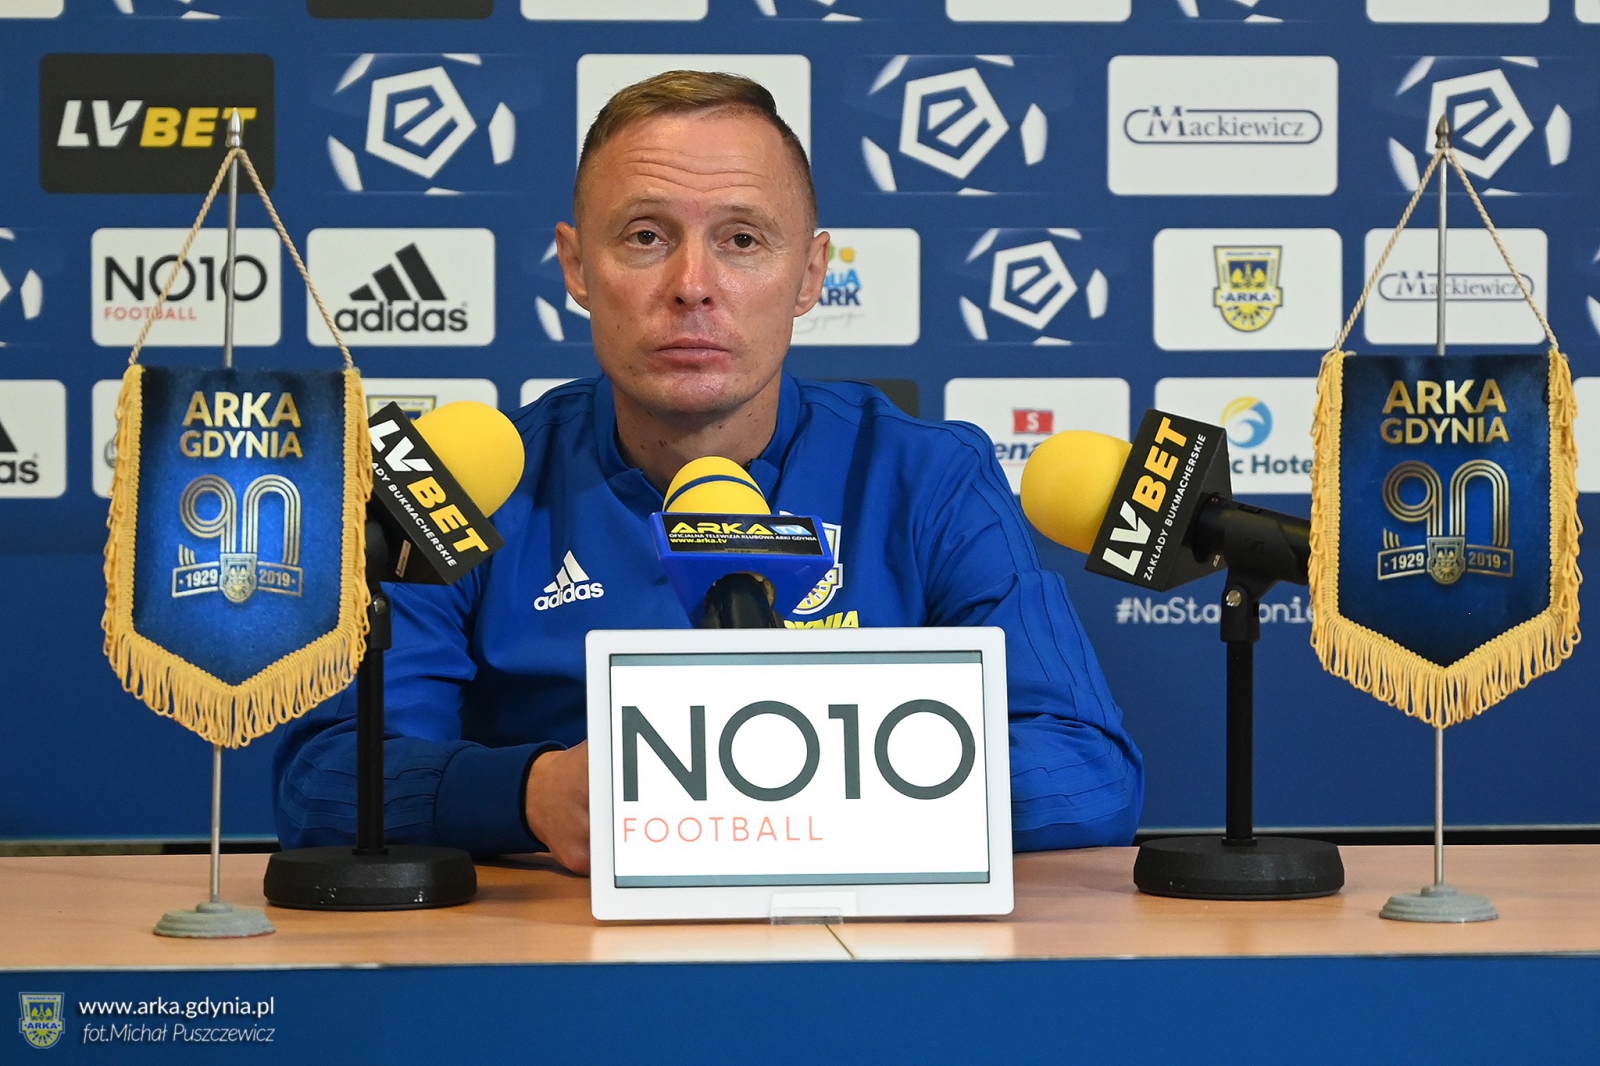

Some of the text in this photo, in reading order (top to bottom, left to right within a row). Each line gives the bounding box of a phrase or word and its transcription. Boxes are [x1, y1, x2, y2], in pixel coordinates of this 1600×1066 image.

[1147, 105, 1305, 139] Mackiewicz
[105, 254, 268, 302] NO10
[1396, 270, 1520, 296] Makiewicz
[1226, 292, 1271, 302] ARKA
[334, 302, 468, 332] adidas
[182, 391, 302, 427] ARKA
[1382, 378, 1508, 414] ARKA
[179, 429, 304, 459] GDYNIA
[1379, 417, 1510, 444] GDYNIA
[1251, 454, 1313, 474] Hote
[1143, 433, 1207, 581] ZAKŁADY BUKMACHERSKIE
[388, 484, 457, 568] BUKMACHERSKIE
[670, 521, 773, 536] ARKA
[1390, 552, 1502, 570] 1929 2019
[185, 568, 291, 588] 1929 2019
[533, 581, 605, 611] adidas
[621, 699, 976, 802] NO10
[622, 815, 824, 843] FOOTBALL
